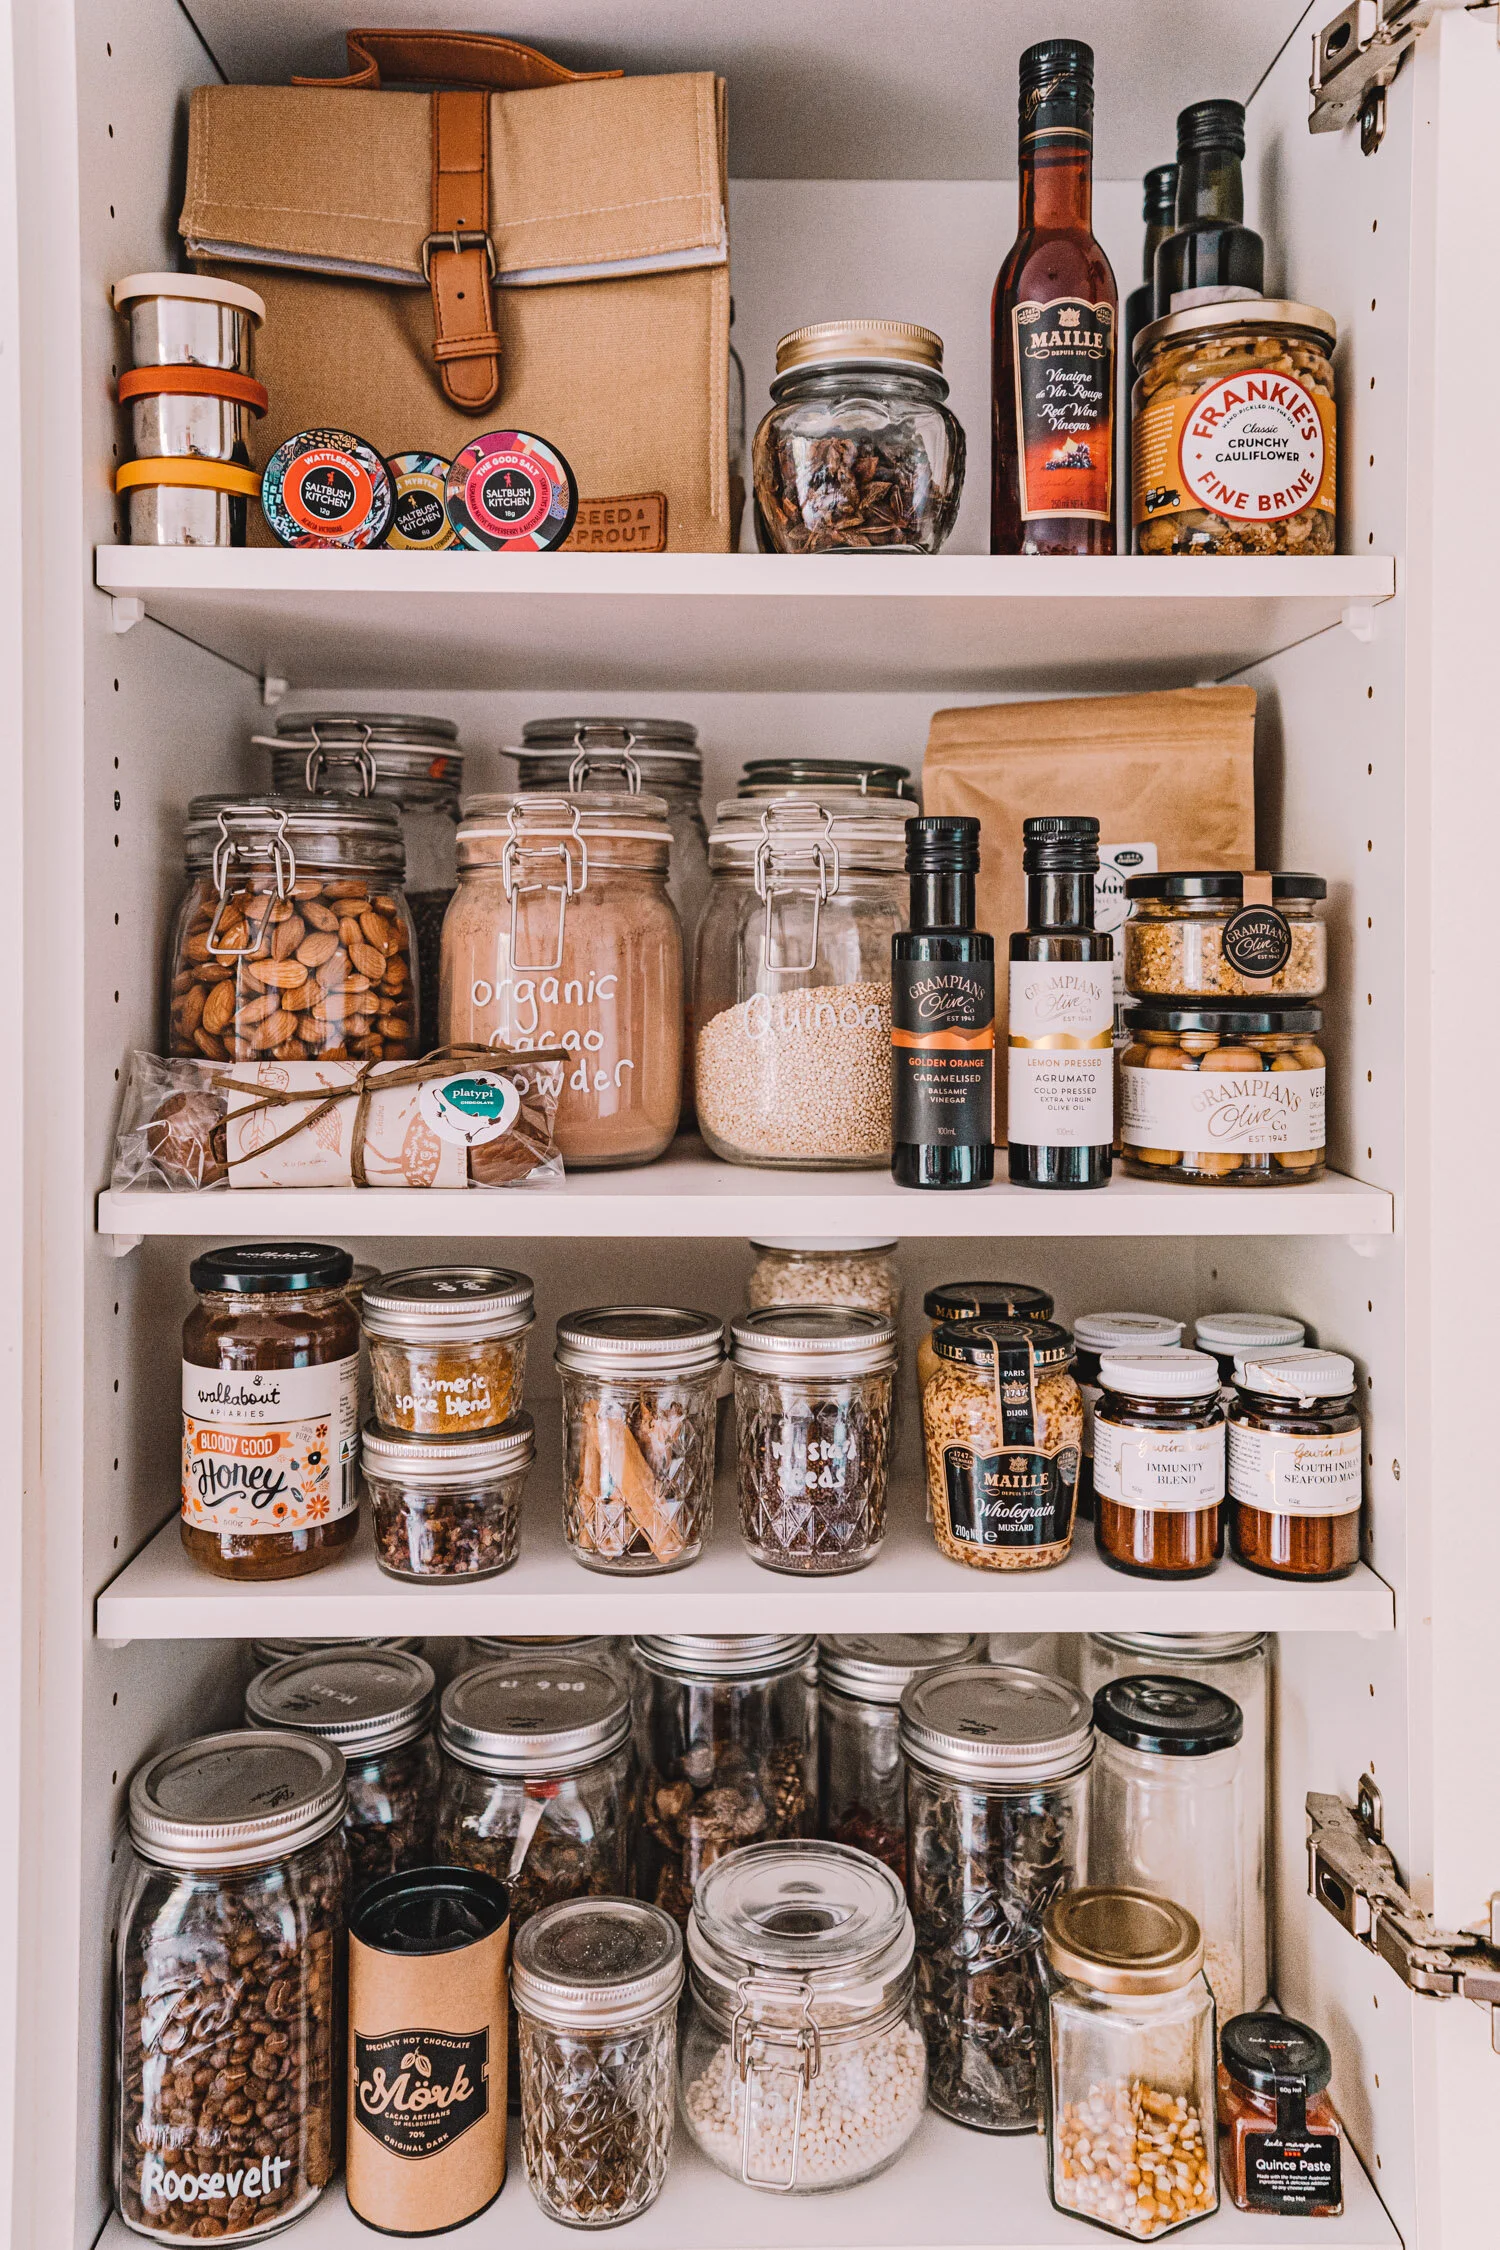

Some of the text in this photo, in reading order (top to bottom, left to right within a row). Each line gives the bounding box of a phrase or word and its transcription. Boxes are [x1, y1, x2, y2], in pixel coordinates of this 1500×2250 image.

[1031, 330, 1103, 348] MAILLE
[1046, 368, 1092, 385] Vinaigre
[1036, 384, 1103, 402] de Vin Rouge
[1037, 402, 1098, 417] Red Wine
[1192, 379, 1318, 442] FRANKIE'S
[1048, 418, 1090, 433] Vinegar
[1276, 408, 1287, 417] THE
[1287, 416, 1296, 428] USA
[1242, 423, 1278, 434] Classic
[1228, 438, 1289, 448] CRUNCHY
[1215, 450, 1300, 463] CAULIFLOWER
[304, 454, 360, 477] WATTLESEED
[476, 456, 540, 477] THE GOOD SALT
[305, 482, 351, 500] SALTBUSH
[405, 478, 438, 490] MYRTLE
[1197, 468, 1315, 511] FINE BRINE
[305, 491, 348, 509] KITCHEN
[486, 488, 531, 498] SALTBUSH
[469, 482, 478, 511] TASMANIAN
[475, 509, 487, 527] NATIVE
[486, 523, 519, 535] PEPPERBERRY
[523, 506, 545, 532] AUSTRALIAN
[488, 498, 530, 507] KITCHEN
[319, 507, 330, 516] 12g
[398, 502, 439, 525] SALTBUSH
[576, 508, 632, 525] SEED
[402, 512, 441, 532] KITCHEN
[1226, 923, 1289, 943] GRAMPIANS
[1235, 937, 1279, 957] Olive
[909, 975, 986, 1001] GRAMPIANS
[472, 970, 618, 1034] organic
[919, 992, 975, 1017] Olive
[963, 1005, 975, 1014] Co
[1035, 993, 1092, 1020] Olive
[909, 1057, 984, 1067] GOLDEN ORANGE
[1027, 1056, 1102, 1067] LEMON PRESSED
[512, 1058, 634, 1097] owder
[913, 1073, 981, 1083] CARAMELISED
[1035, 1074, 1096, 1083] AGRUMATO
[452, 1088, 493, 1099] platypi
[928, 1087, 967, 1095] BALSAMIC
[1061, 1087, 1097, 1095] PRESSED
[1191, 1079, 1301, 1112] GRAMPIANS
[1208, 1103, 1286, 1137] Olive
[1271, 1120, 1287, 1131] Co
[938, 1127, 956, 1135] 100mL
[1268, 1134, 1287, 1142] 1943
[198, 1382, 280, 1405] walkabout
[396, 1390, 491, 1417] spice blend
[210, 1408, 264, 1417] APIARIES
[1006, 1409, 1028, 1417] DIJON
[201, 1433, 273, 1455] BLOODY GOOD
[296, 1431, 312, 1443] PURE
[953, 1450, 969, 1459] 1747
[1147, 1462, 1204, 1472] IMMUNITY
[1294, 1461, 1332, 1473] SOUTH
[192, 1458, 288, 1509] Honey
[984, 1472, 1049, 1488] MAILLE
[1157, 1475, 1196, 1485] BLEND
[1284, 1474, 1337, 1484] SEAFOOD
[974, 1498, 1056, 1523] Wholegrain
[223, 1519, 243, 1527] 500g
[998, 1523, 1034, 1532] MUSTARD
[955, 1524, 970, 1541] 210g
[365, 2036, 470, 2052] SPECIALTY HOT CHOCOLATE
[360, 2064, 475, 2115] Mörk
[384, 2109, 451, 2121] CACAO ARTISANS
[403, 2119, 441, 2127] MELBOURNE
[384, 2132, 449, 2152] ORIGINAL DARK
[1256, 2158, 1331, 2172] Quince Paste
[142, 2154, 291, 2203] Roosevelt
